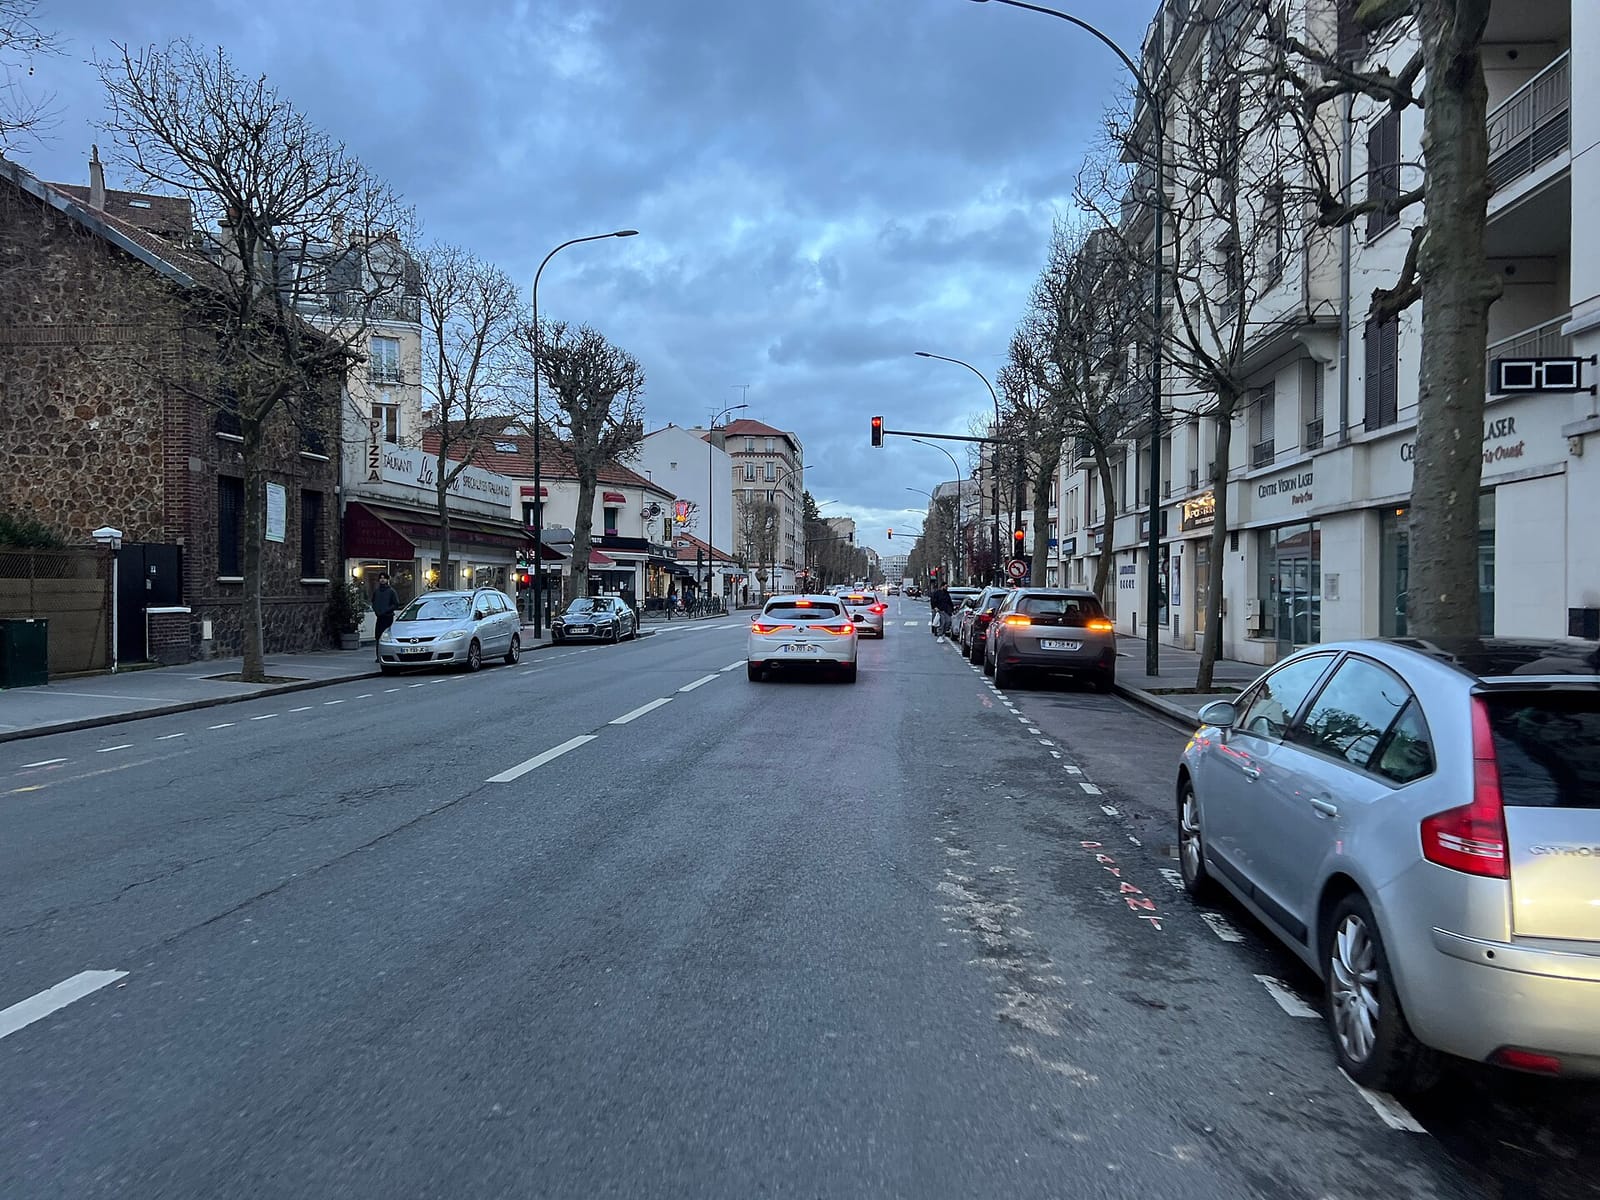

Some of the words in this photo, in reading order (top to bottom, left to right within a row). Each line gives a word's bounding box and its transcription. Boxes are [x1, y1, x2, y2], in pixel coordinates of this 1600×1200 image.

[1482, 417, 1517, 441] LASER
[368, 420, 380, 481] PIZZA
[1258, 483, 1277, 498] CENTRE
[1278, 478, 1297, 493] VISION
